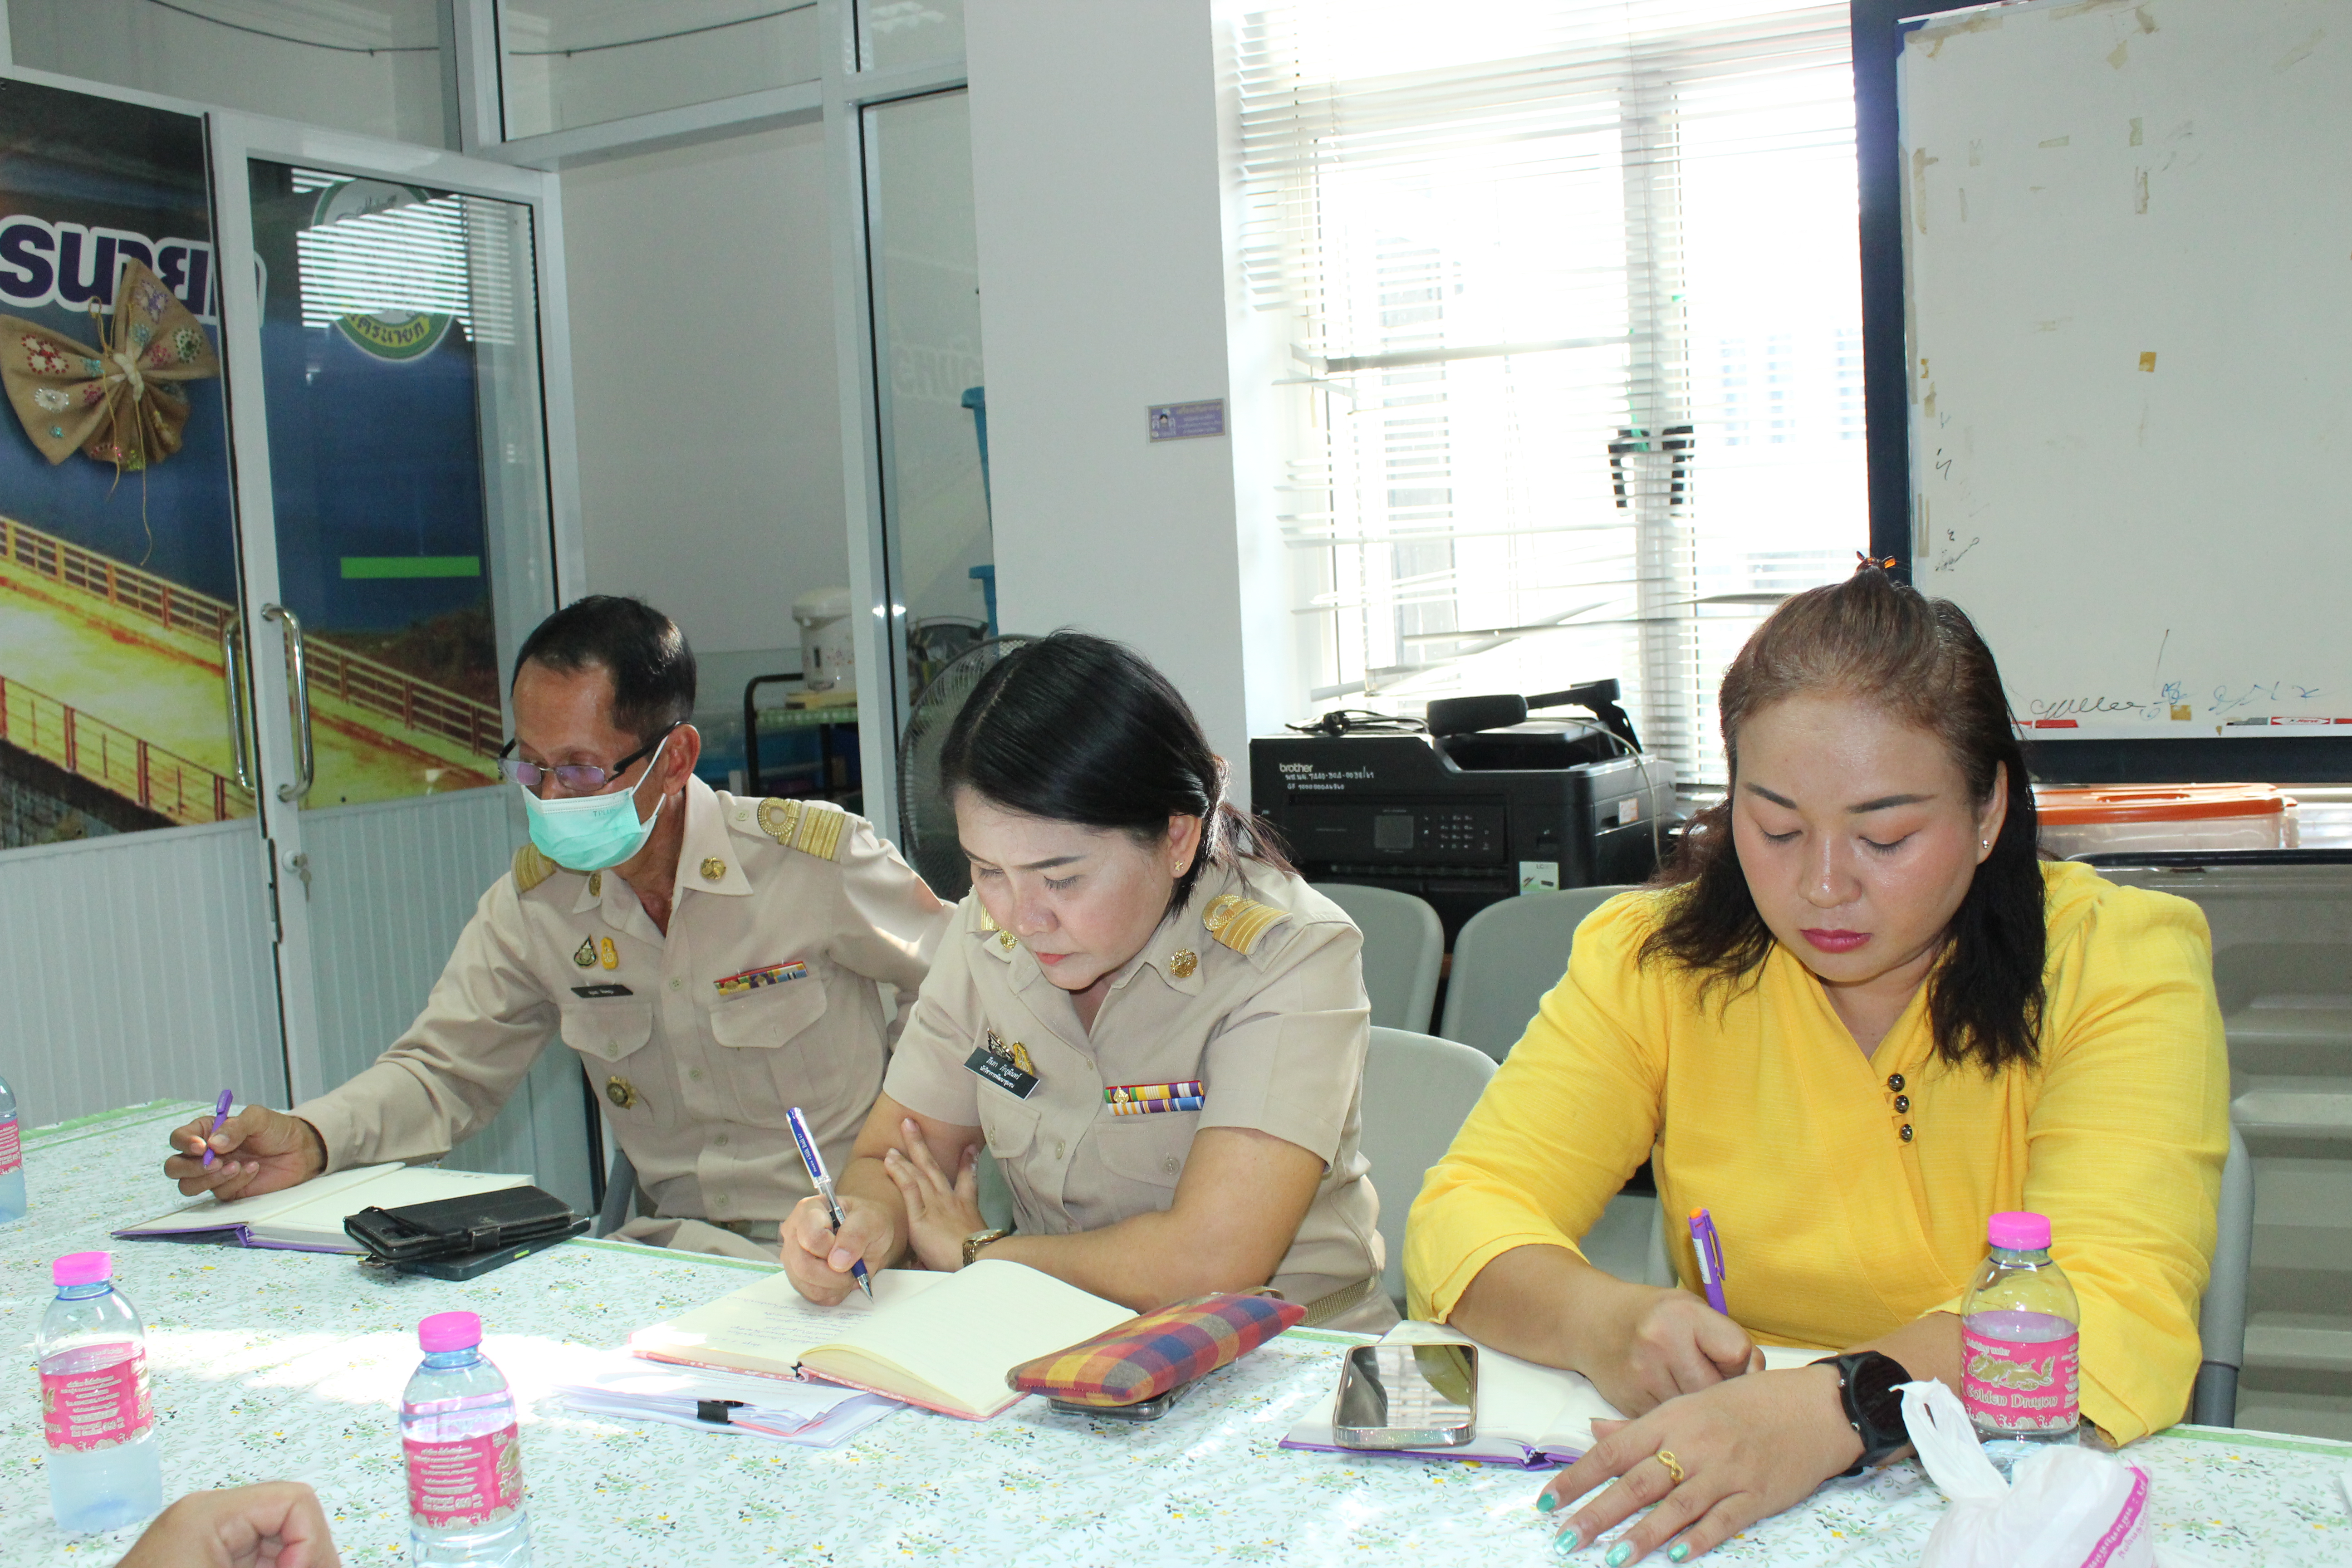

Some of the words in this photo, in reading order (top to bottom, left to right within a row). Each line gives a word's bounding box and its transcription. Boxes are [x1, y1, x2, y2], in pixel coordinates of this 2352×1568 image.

[346, 313, 424, 344] ครนายก
[1279, 763, 1313, 773] brother
[1967, 1384, 2008, 1406] Golden
[2011, 1393, 2058, 1410] Dragon
